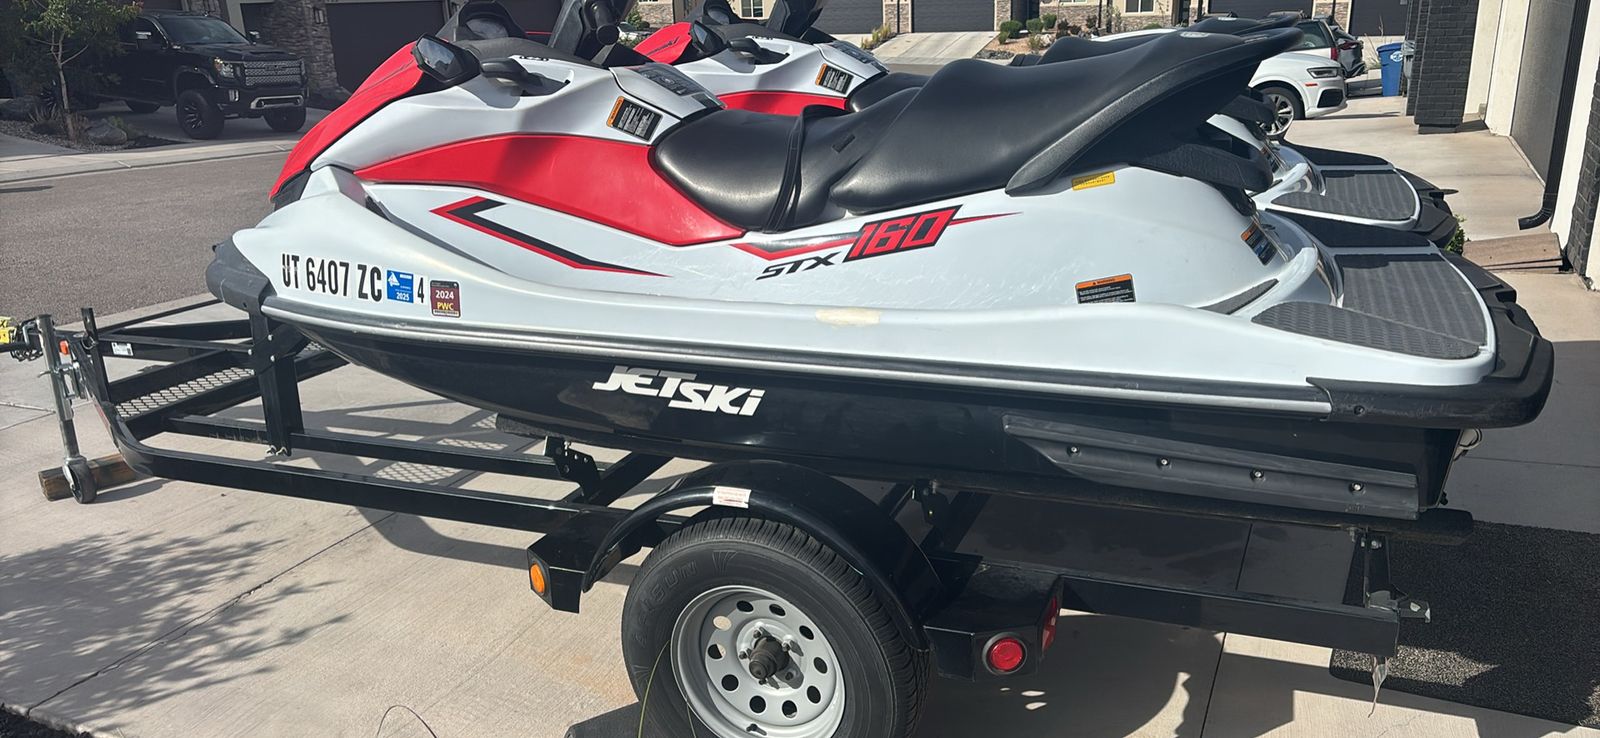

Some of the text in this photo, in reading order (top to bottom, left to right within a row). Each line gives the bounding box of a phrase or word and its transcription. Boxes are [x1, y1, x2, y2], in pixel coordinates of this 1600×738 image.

[755, 208, 956, 281] STX 160
[282, 253, 383, 302] UT 6407 ZC
[396, 291, 410, 302] 2025
[417, 276, 425, 304] 4
[435, 289, 455, 300] 2024
[436, 301, 455, 311] PWC
